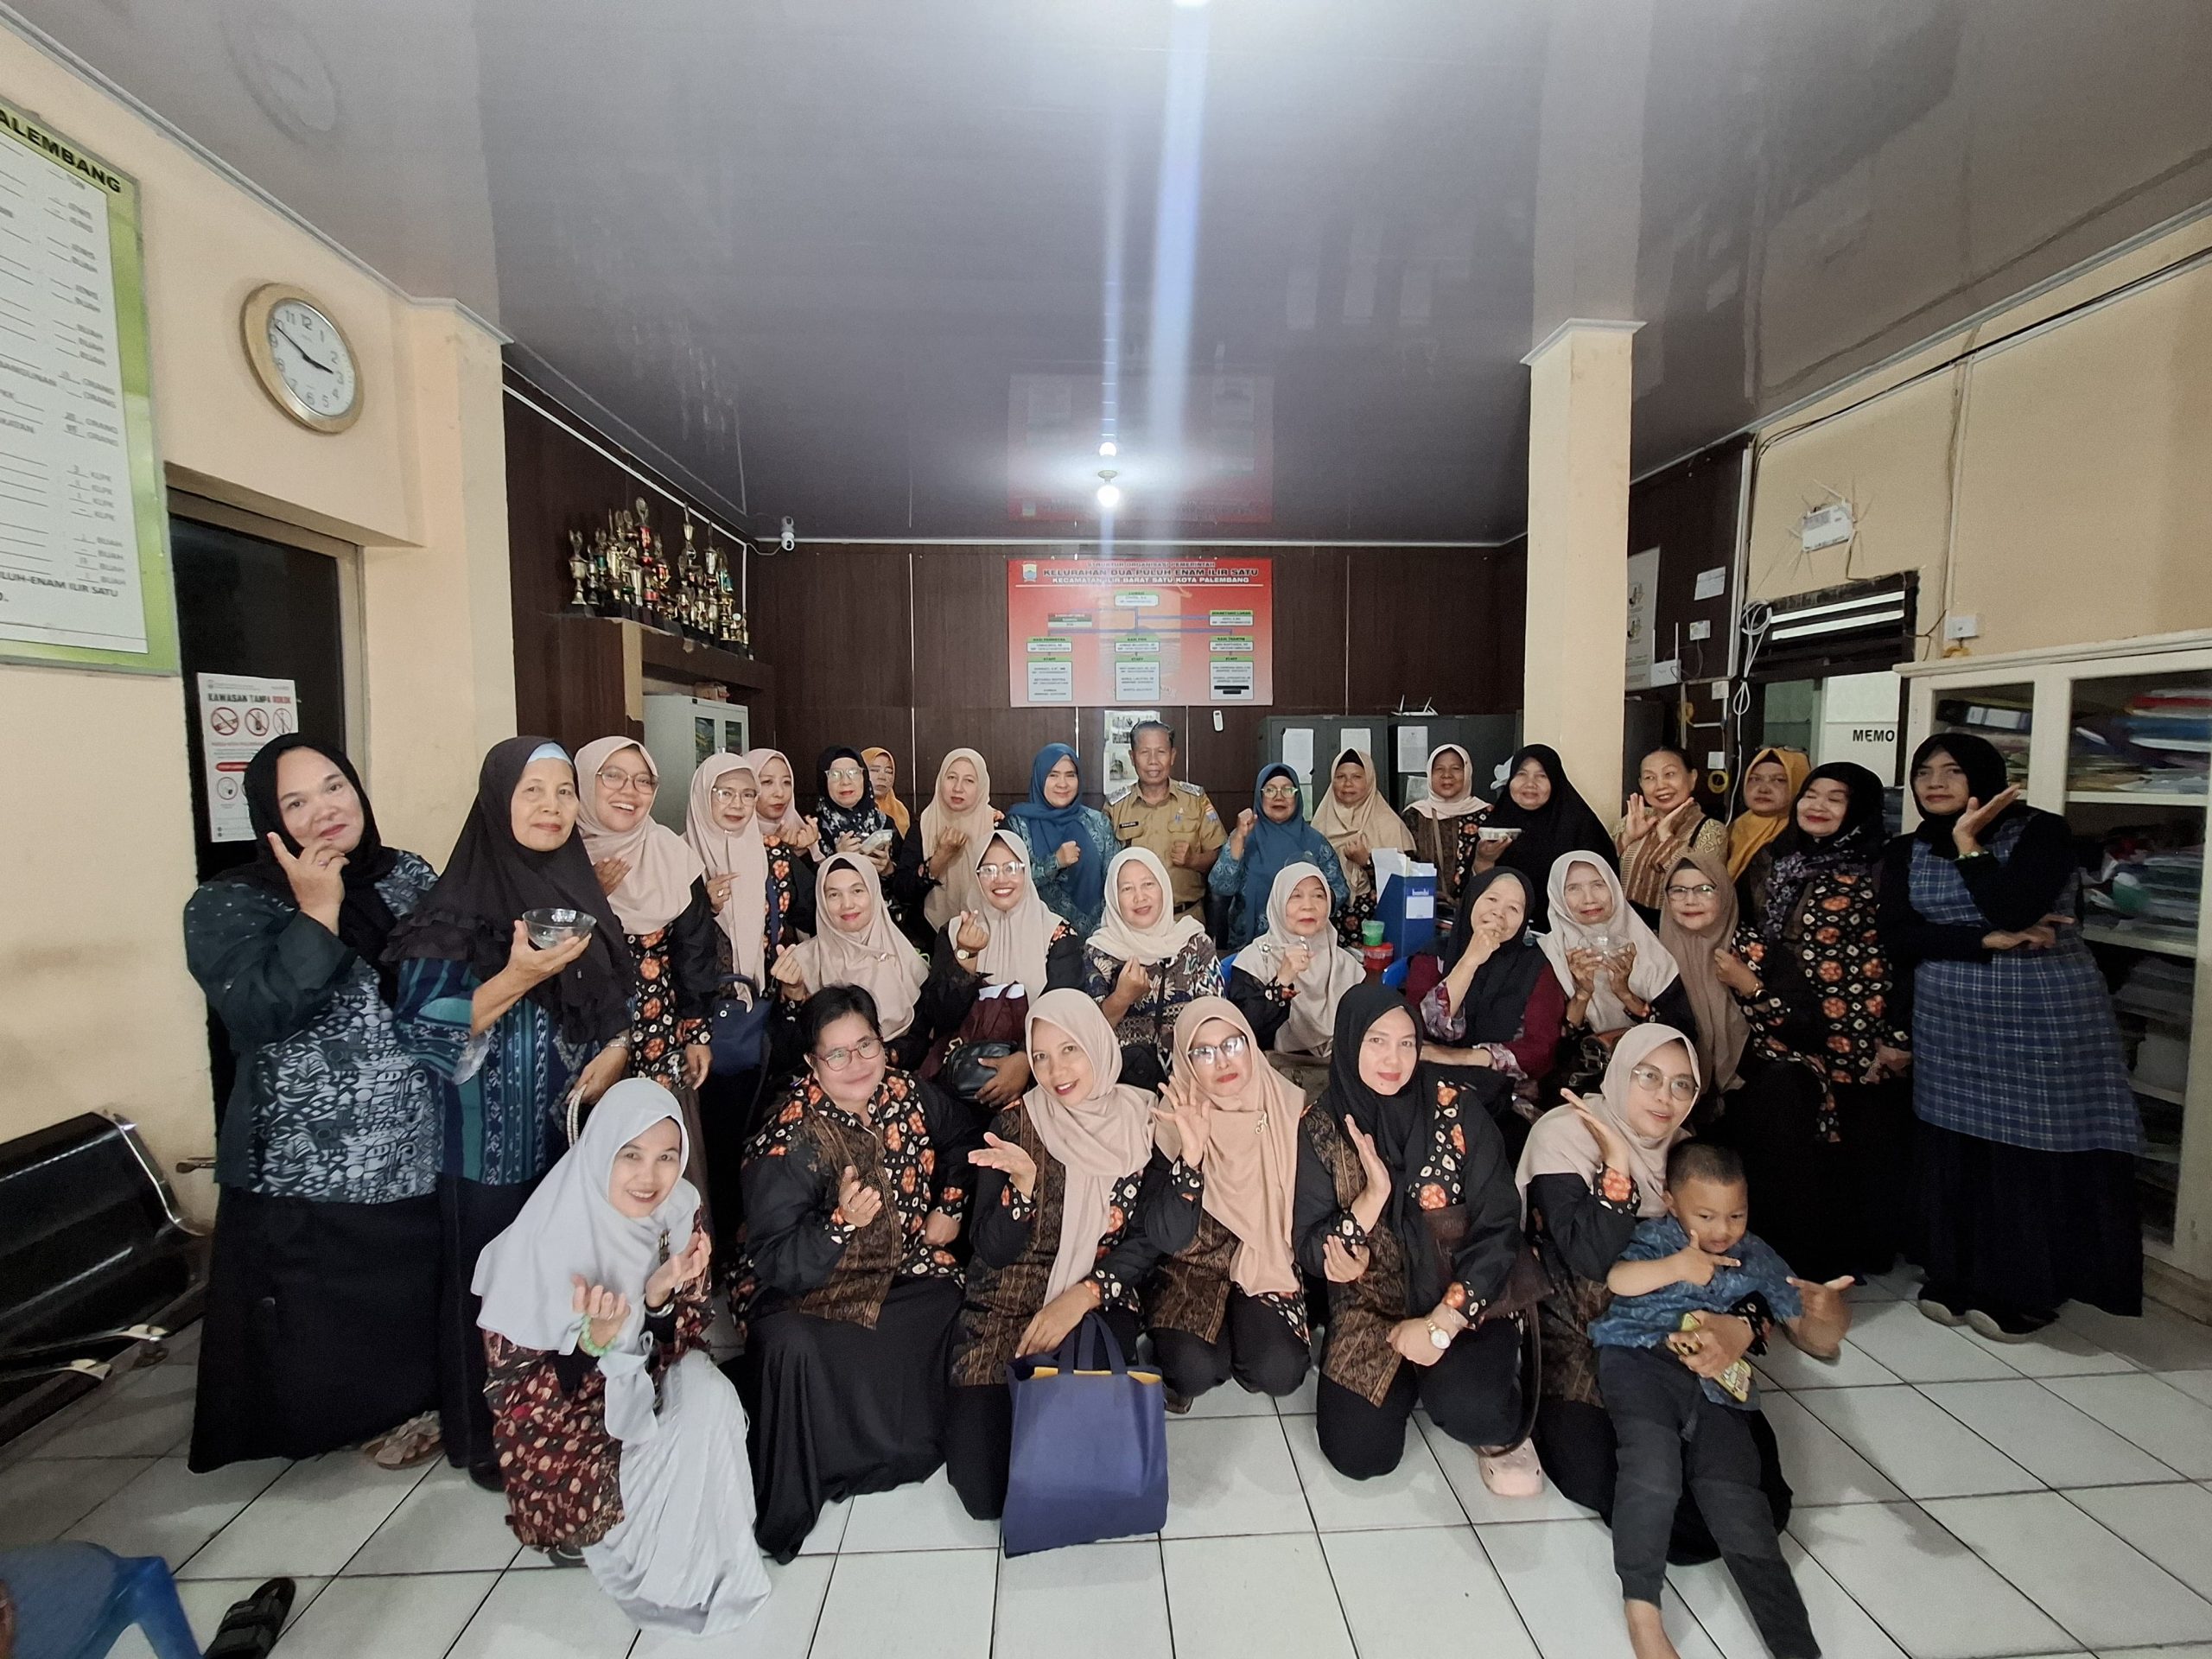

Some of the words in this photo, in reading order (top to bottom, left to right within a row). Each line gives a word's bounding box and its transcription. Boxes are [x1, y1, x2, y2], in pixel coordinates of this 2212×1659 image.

[285, 310, 296, 326] 11
[301, 314, 312, 330] 12
[330, 351, 340, 365] 2
[306, 391, 315, 405] 6
[91, 587, 118, 597] SATU
[208, 693, 248, 702] KAWASAN
[1852, 729, 1895, 742] MEMO
